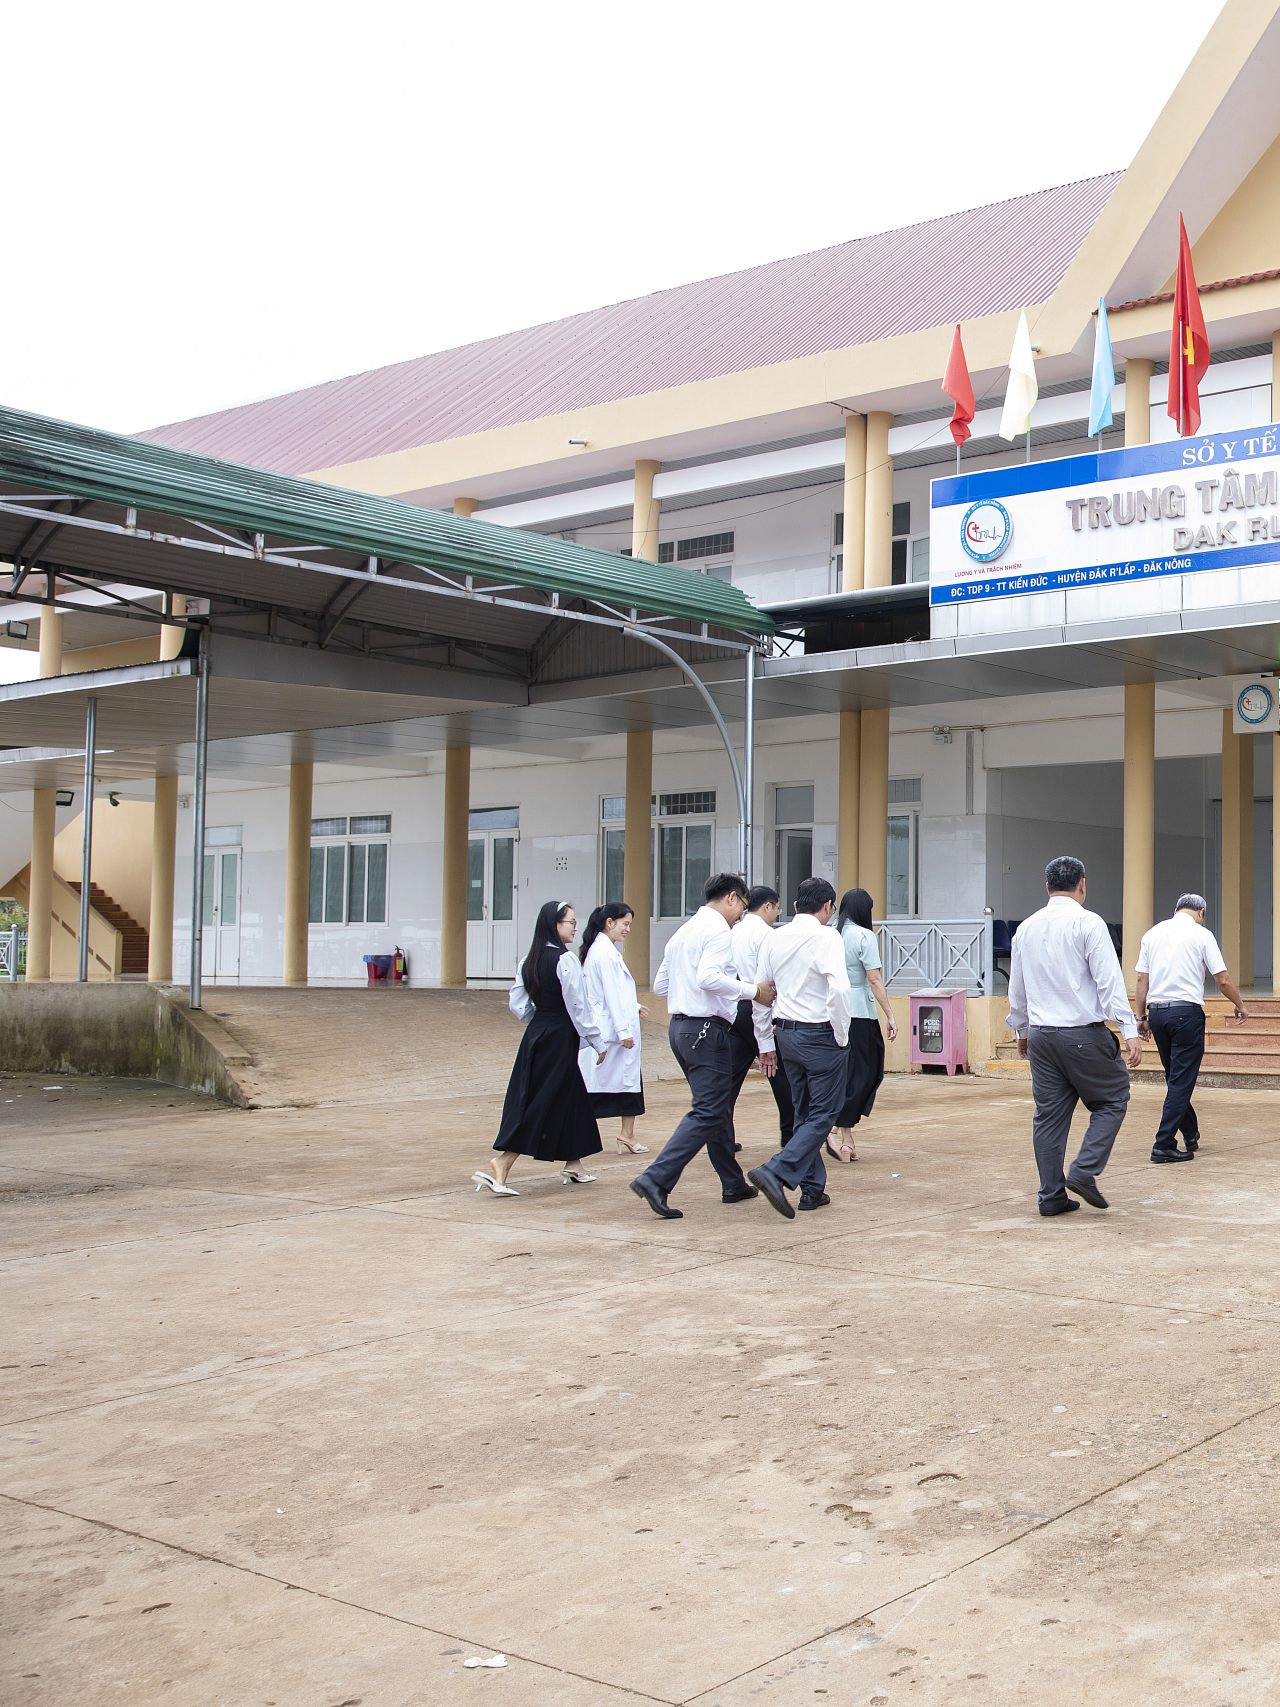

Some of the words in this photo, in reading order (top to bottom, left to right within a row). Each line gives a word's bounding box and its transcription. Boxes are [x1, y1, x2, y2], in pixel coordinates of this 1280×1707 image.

[1182, 438, 1215, 466] SỞ
[1221, 441, 1238, 459] Y
[1244, 427, 1278, 456] TẾ
[1065, 484, 1186, 532] TRUNG
[1195, 468, 1278, 514] TÂM
[1173, 520, 1239, 552] DAK
[951, 587, 965, 597] ĐC:
[967, 585, 983, 595] TDP
[985, 584, 990, 593] 9
[996, 581, 1007, 591] TT
[1008, 576, 1029, 590] KIẾN
[1030, 575, 1048, 587] ĐỨC
[1057, 570, 1087, 584] HUYỆN
[1165, 557, 1192, 571] NÔNG
[986, 565, 1004, 573] TRÁCH
[923, 1018, 940, 1026] PCCC
